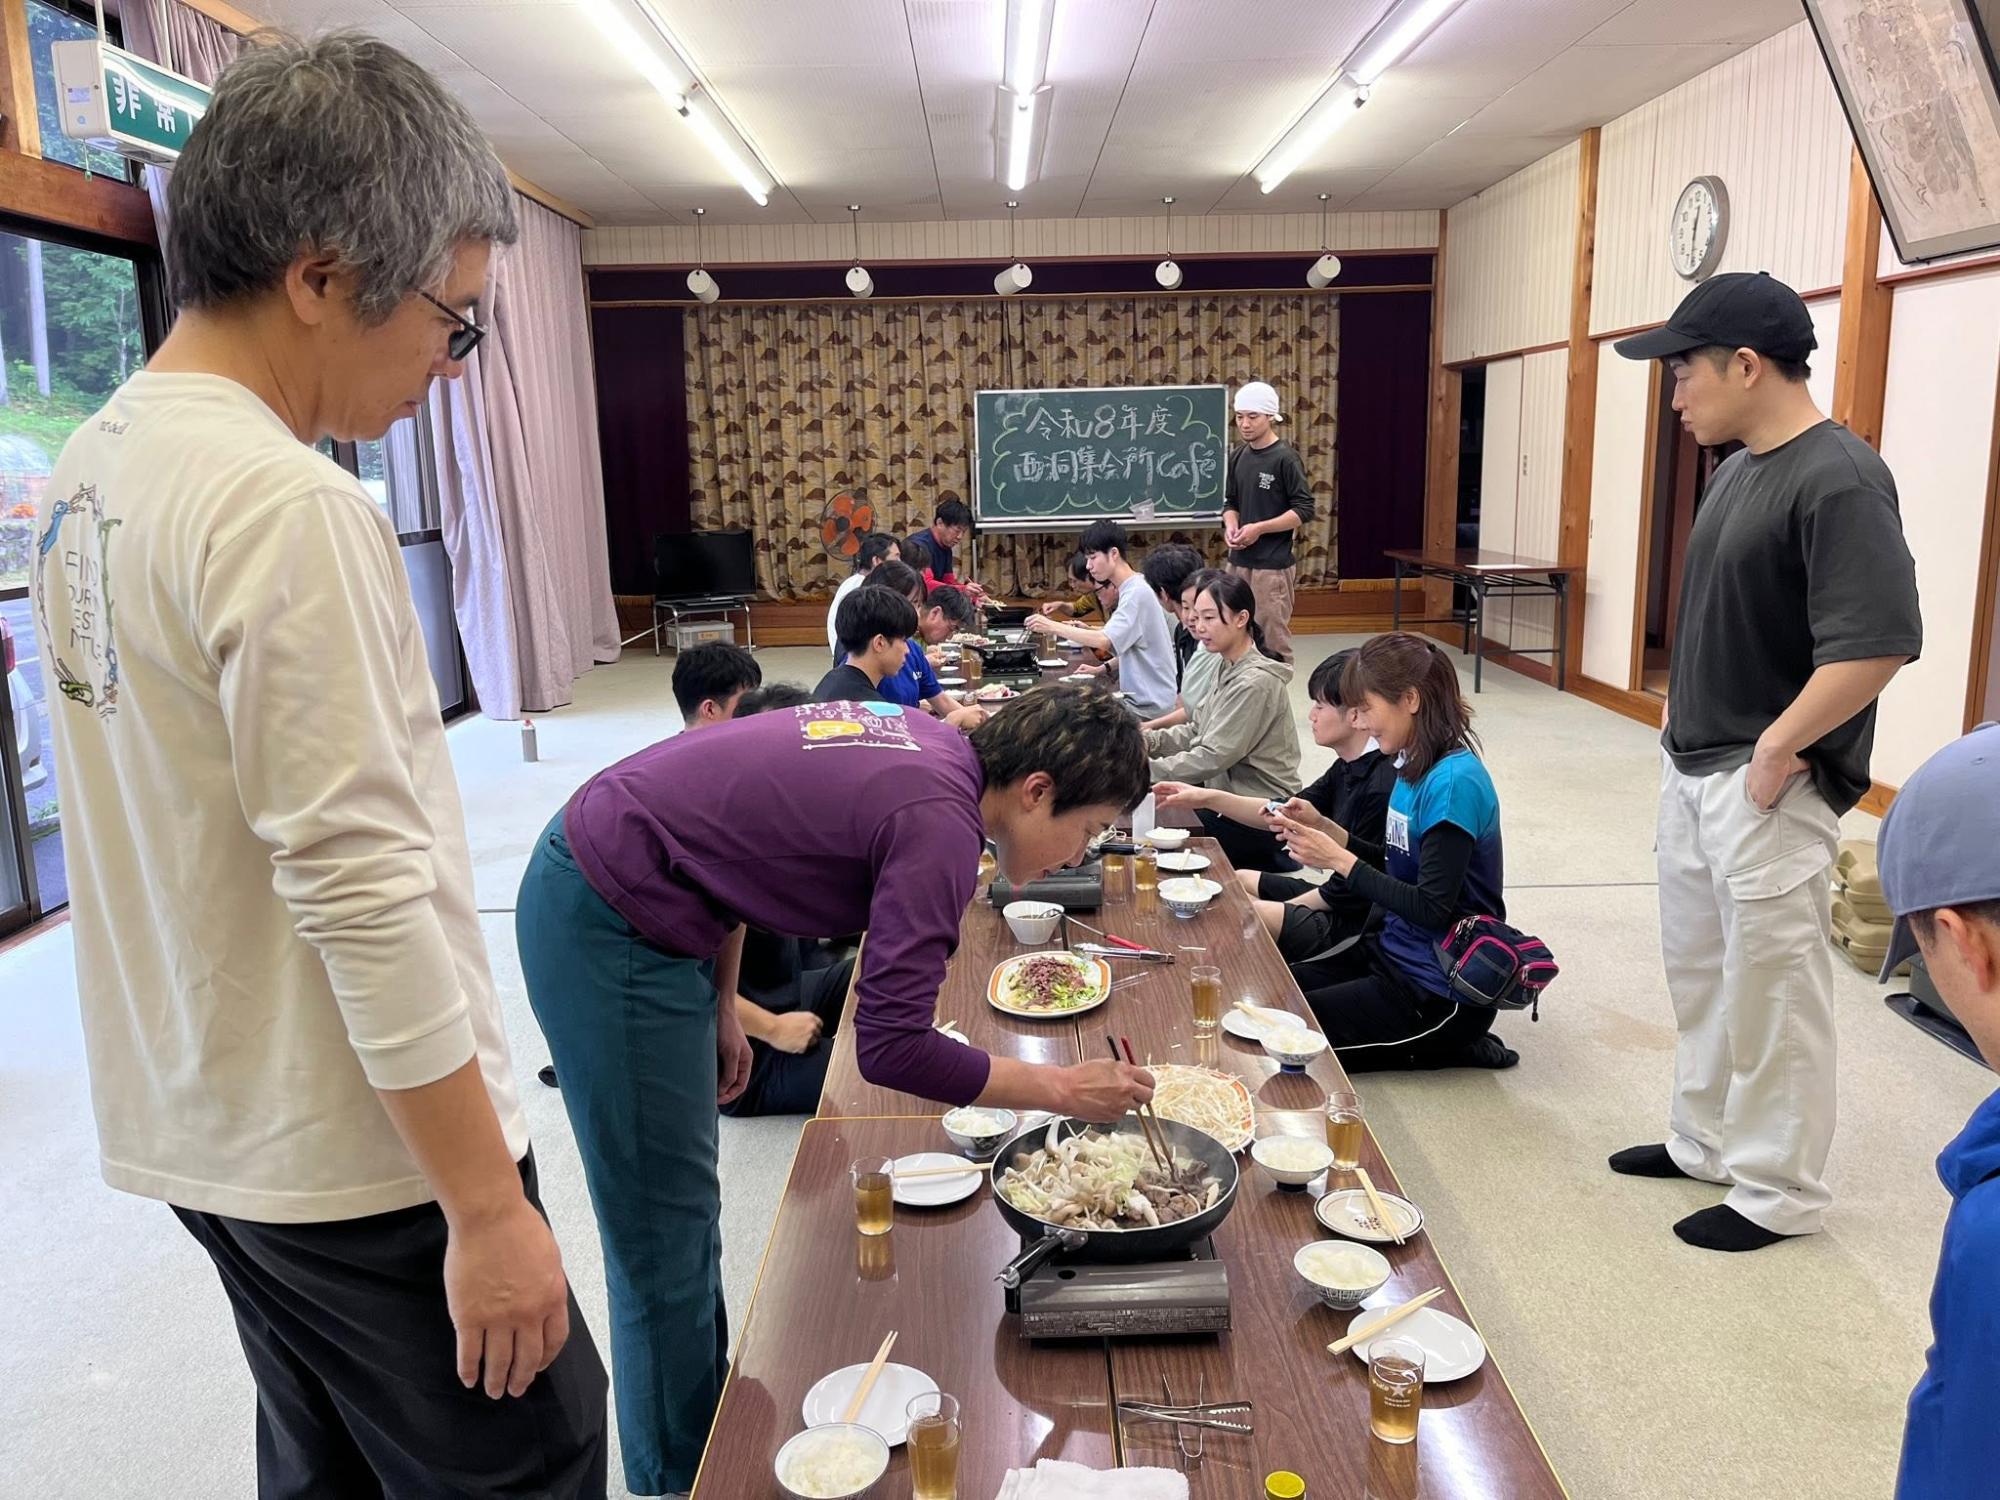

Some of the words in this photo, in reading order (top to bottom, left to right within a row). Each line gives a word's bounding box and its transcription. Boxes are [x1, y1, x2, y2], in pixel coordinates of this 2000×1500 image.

[112, 74, 193, 135] 非常
[1025, 404, 1176, 441] 令和8年度
